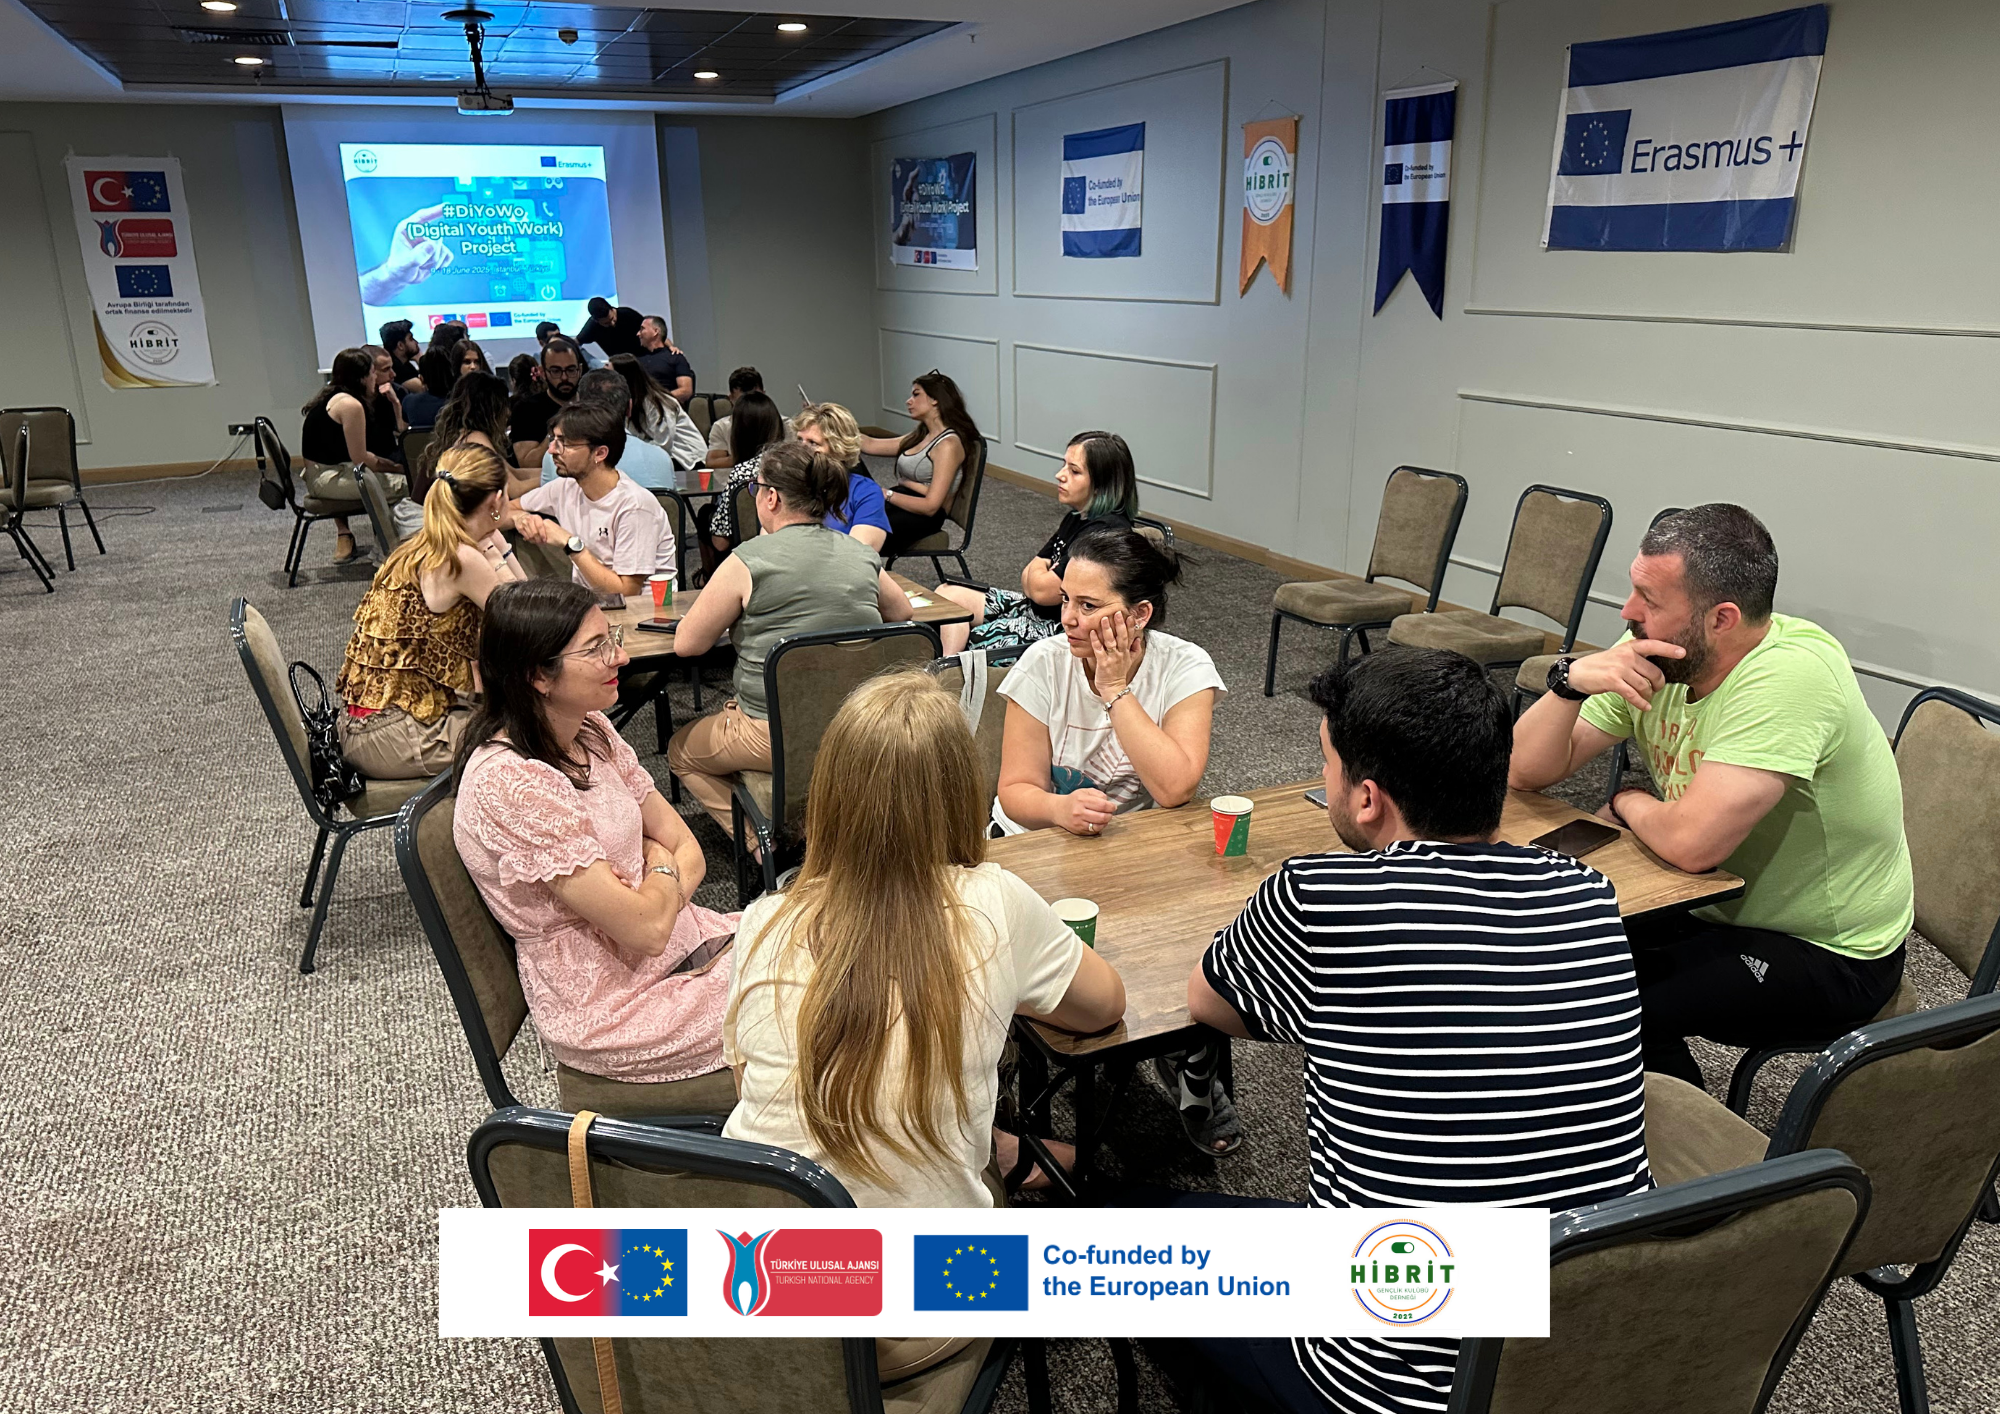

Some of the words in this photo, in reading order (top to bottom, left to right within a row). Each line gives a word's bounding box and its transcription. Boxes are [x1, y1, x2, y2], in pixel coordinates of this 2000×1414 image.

[1088, 177, 1116, 190] Co-funded
[1117, 177, 1123, 190] by
[1246, 169, 1290, 191] HİBRİT
[948, 199, 970, 215] Project
[1088, 196, 1097, 206] the
[1098, 194, 1120, 207] European
[1121, 191, 1140, 203] Union
[443, 204, 525, 218] #DiYoWo
[407, 222, 464, 240] (Digital
[466, 222, 513, 236] Youth
[517, 221, 563, 237] Work)
[461, 240, 516, 256] Project
[452, 266, 471, 275] June
[130, 337, 178, 349] HİBRİT
[1740, 954, 1764, 983] adidas
